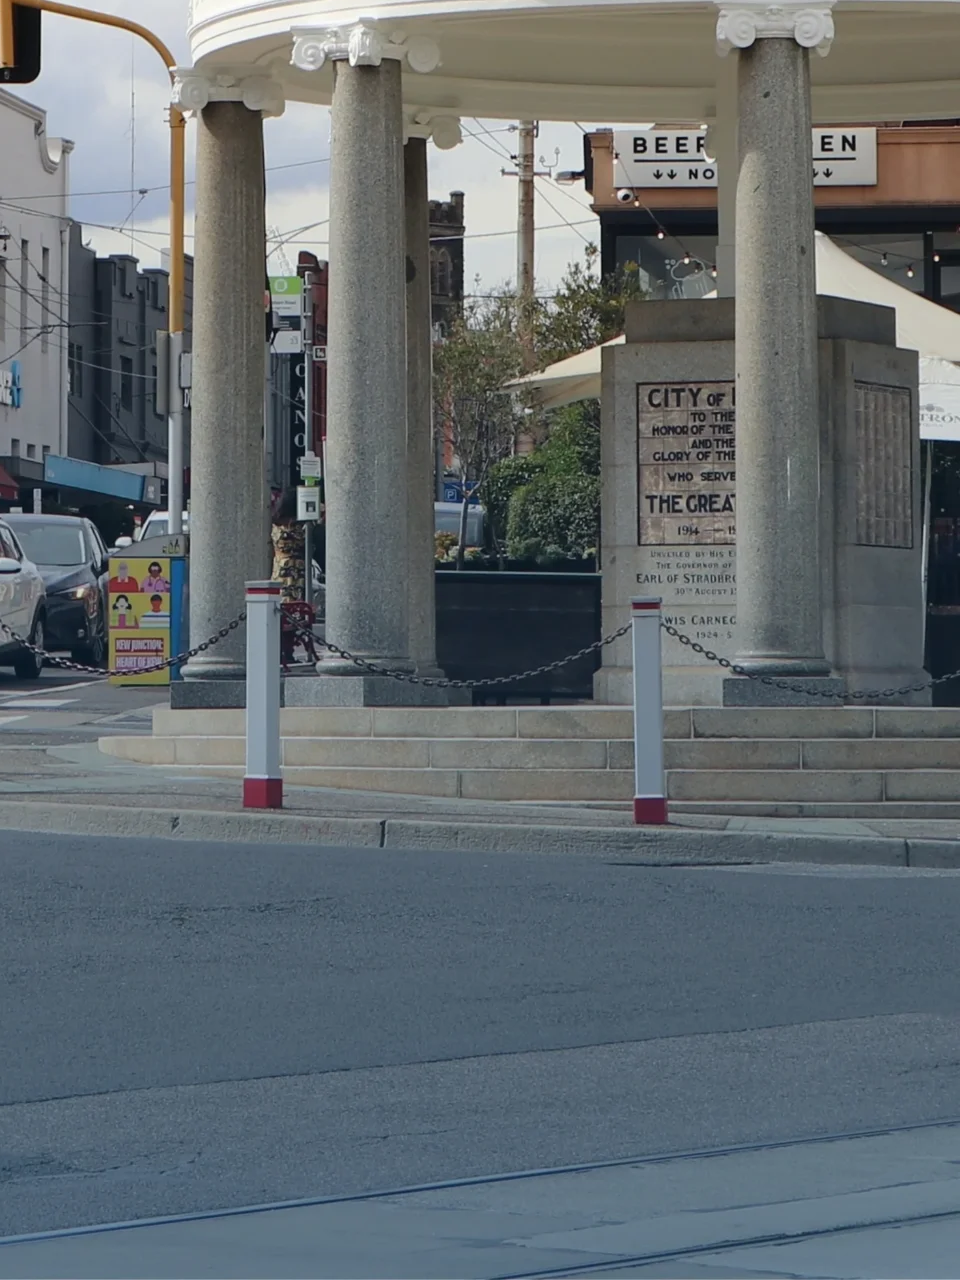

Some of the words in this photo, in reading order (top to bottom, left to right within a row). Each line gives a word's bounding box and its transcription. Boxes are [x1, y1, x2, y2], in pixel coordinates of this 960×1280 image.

[647, 387, 702, 408] CITY
[706, 393, 725, 407] OF
[690, 412, 706, 423] TO
[712, 411, 736, 422] THE
[652, 425, 689, 436] HONOR
[690, 424, 705, 436] OF
[710, 424, 733, 435] THE
[690, 438, 712, 449] AND
[713, 438, 736, 449] THE
[652, 451, 691, 462] GLORY
[696, 451, 711, 462] OF
[715, 450, 736, 461] THE
[667, 472, 693, 483] WHO
[645, 494, 683, 514] THE
[709, 550, 724, 558] HIS
[656, 561, 671, 570] THE
[676, 561, 719, 570] GOVERNOR
[636, 573, 663, 584] EARL
[666, 574, 679, 584] OF
[694, 587, 728, 596] AUGUST
